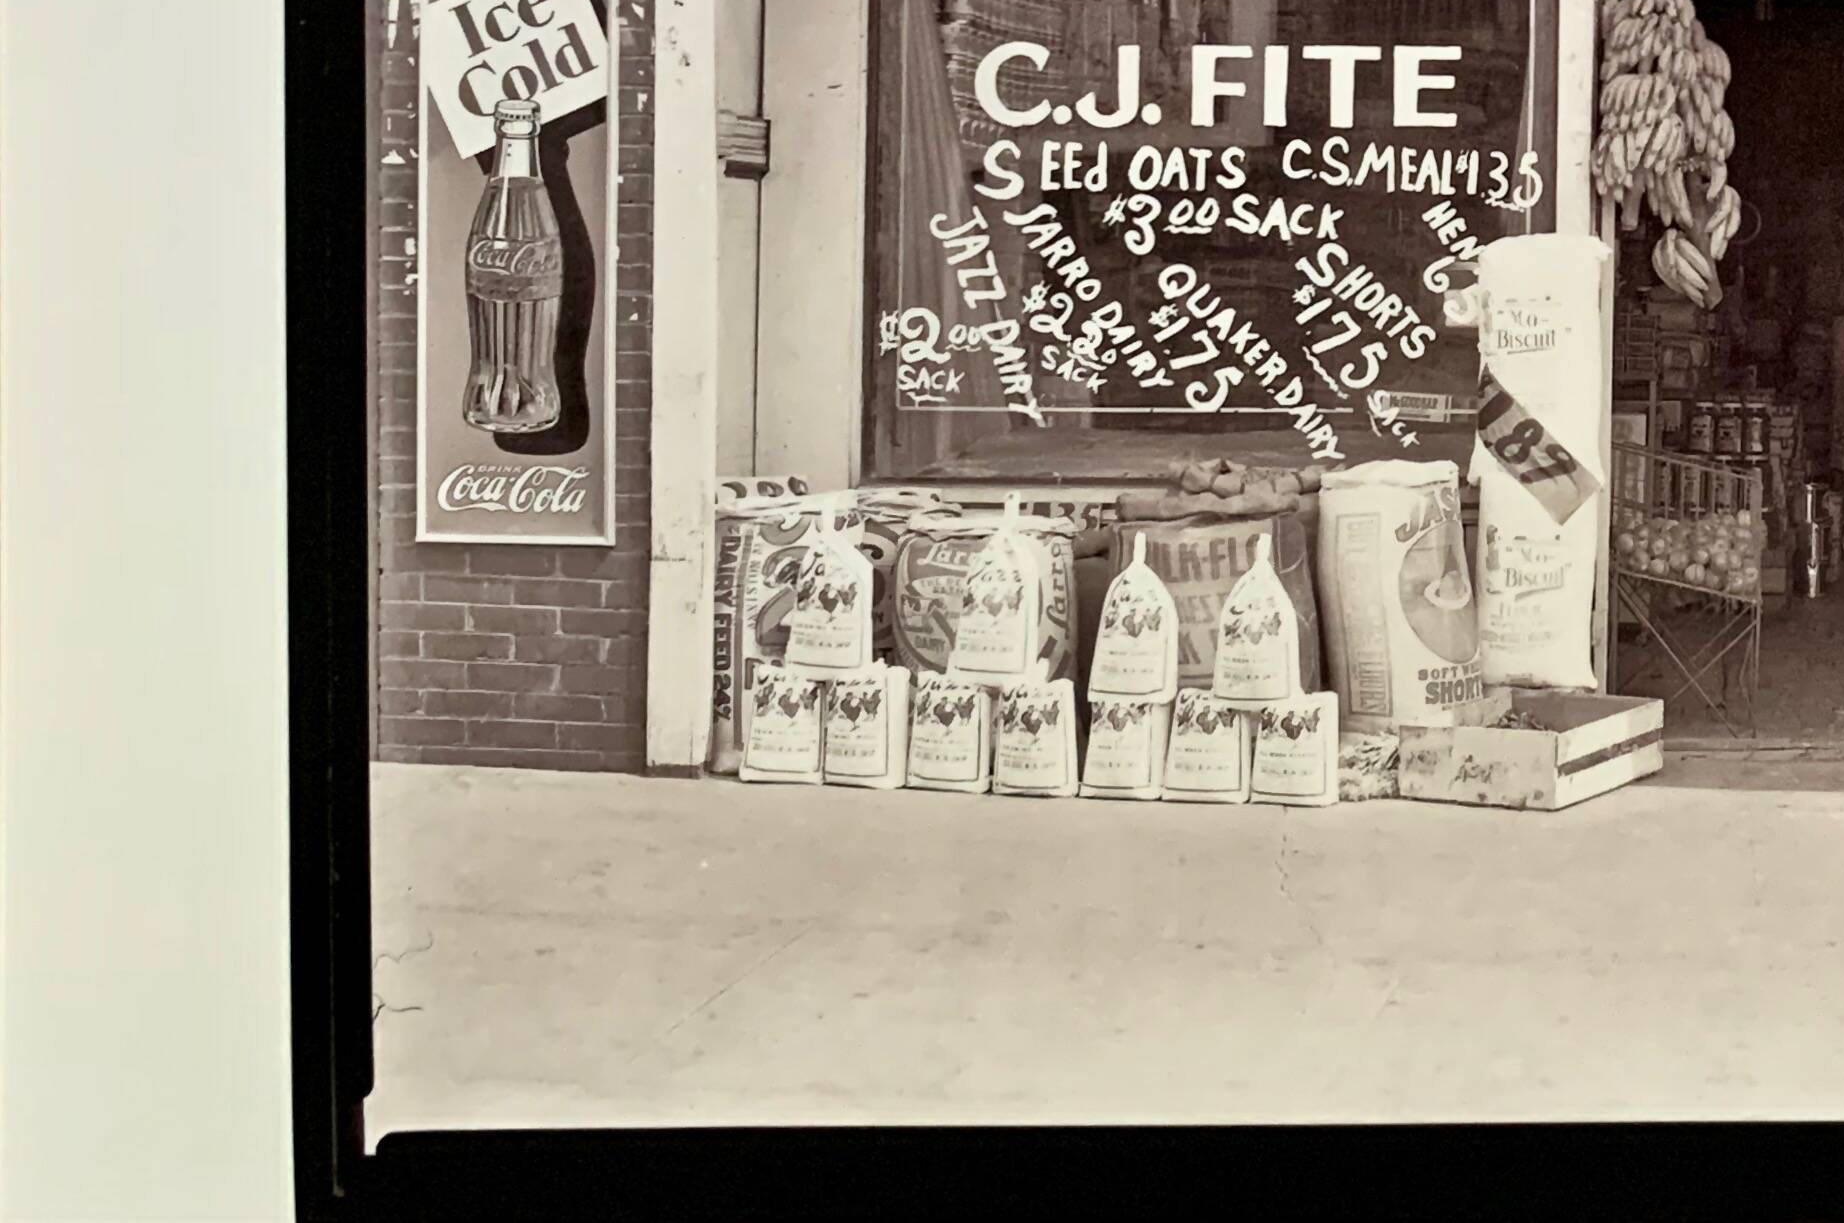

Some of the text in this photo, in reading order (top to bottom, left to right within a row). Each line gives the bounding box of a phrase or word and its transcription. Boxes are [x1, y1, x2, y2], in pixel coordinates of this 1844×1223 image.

[458, 22, 599, 118] Cold
[1192, 45, 1463, 128] FITE
[1130, 147, 1245, 191] OATS
[1226, 193, 1345, 240] SACK
[930, 206, 1047, 428] JAZZ DAIRY
[1296, 243, 1437, 359] SHORTS
[898, 365, 965, 393] SACK
[1042, 345, 1108, 394] SACK
[1091, 301, 1174, 387] DAIRY
[1274, 377, 1346, 459] DAIRY
[437, 463, 591, 514] Coca-Cola
[714, 536, 741, 608] DAIRY
[714, 613, 733, 671] FEED
